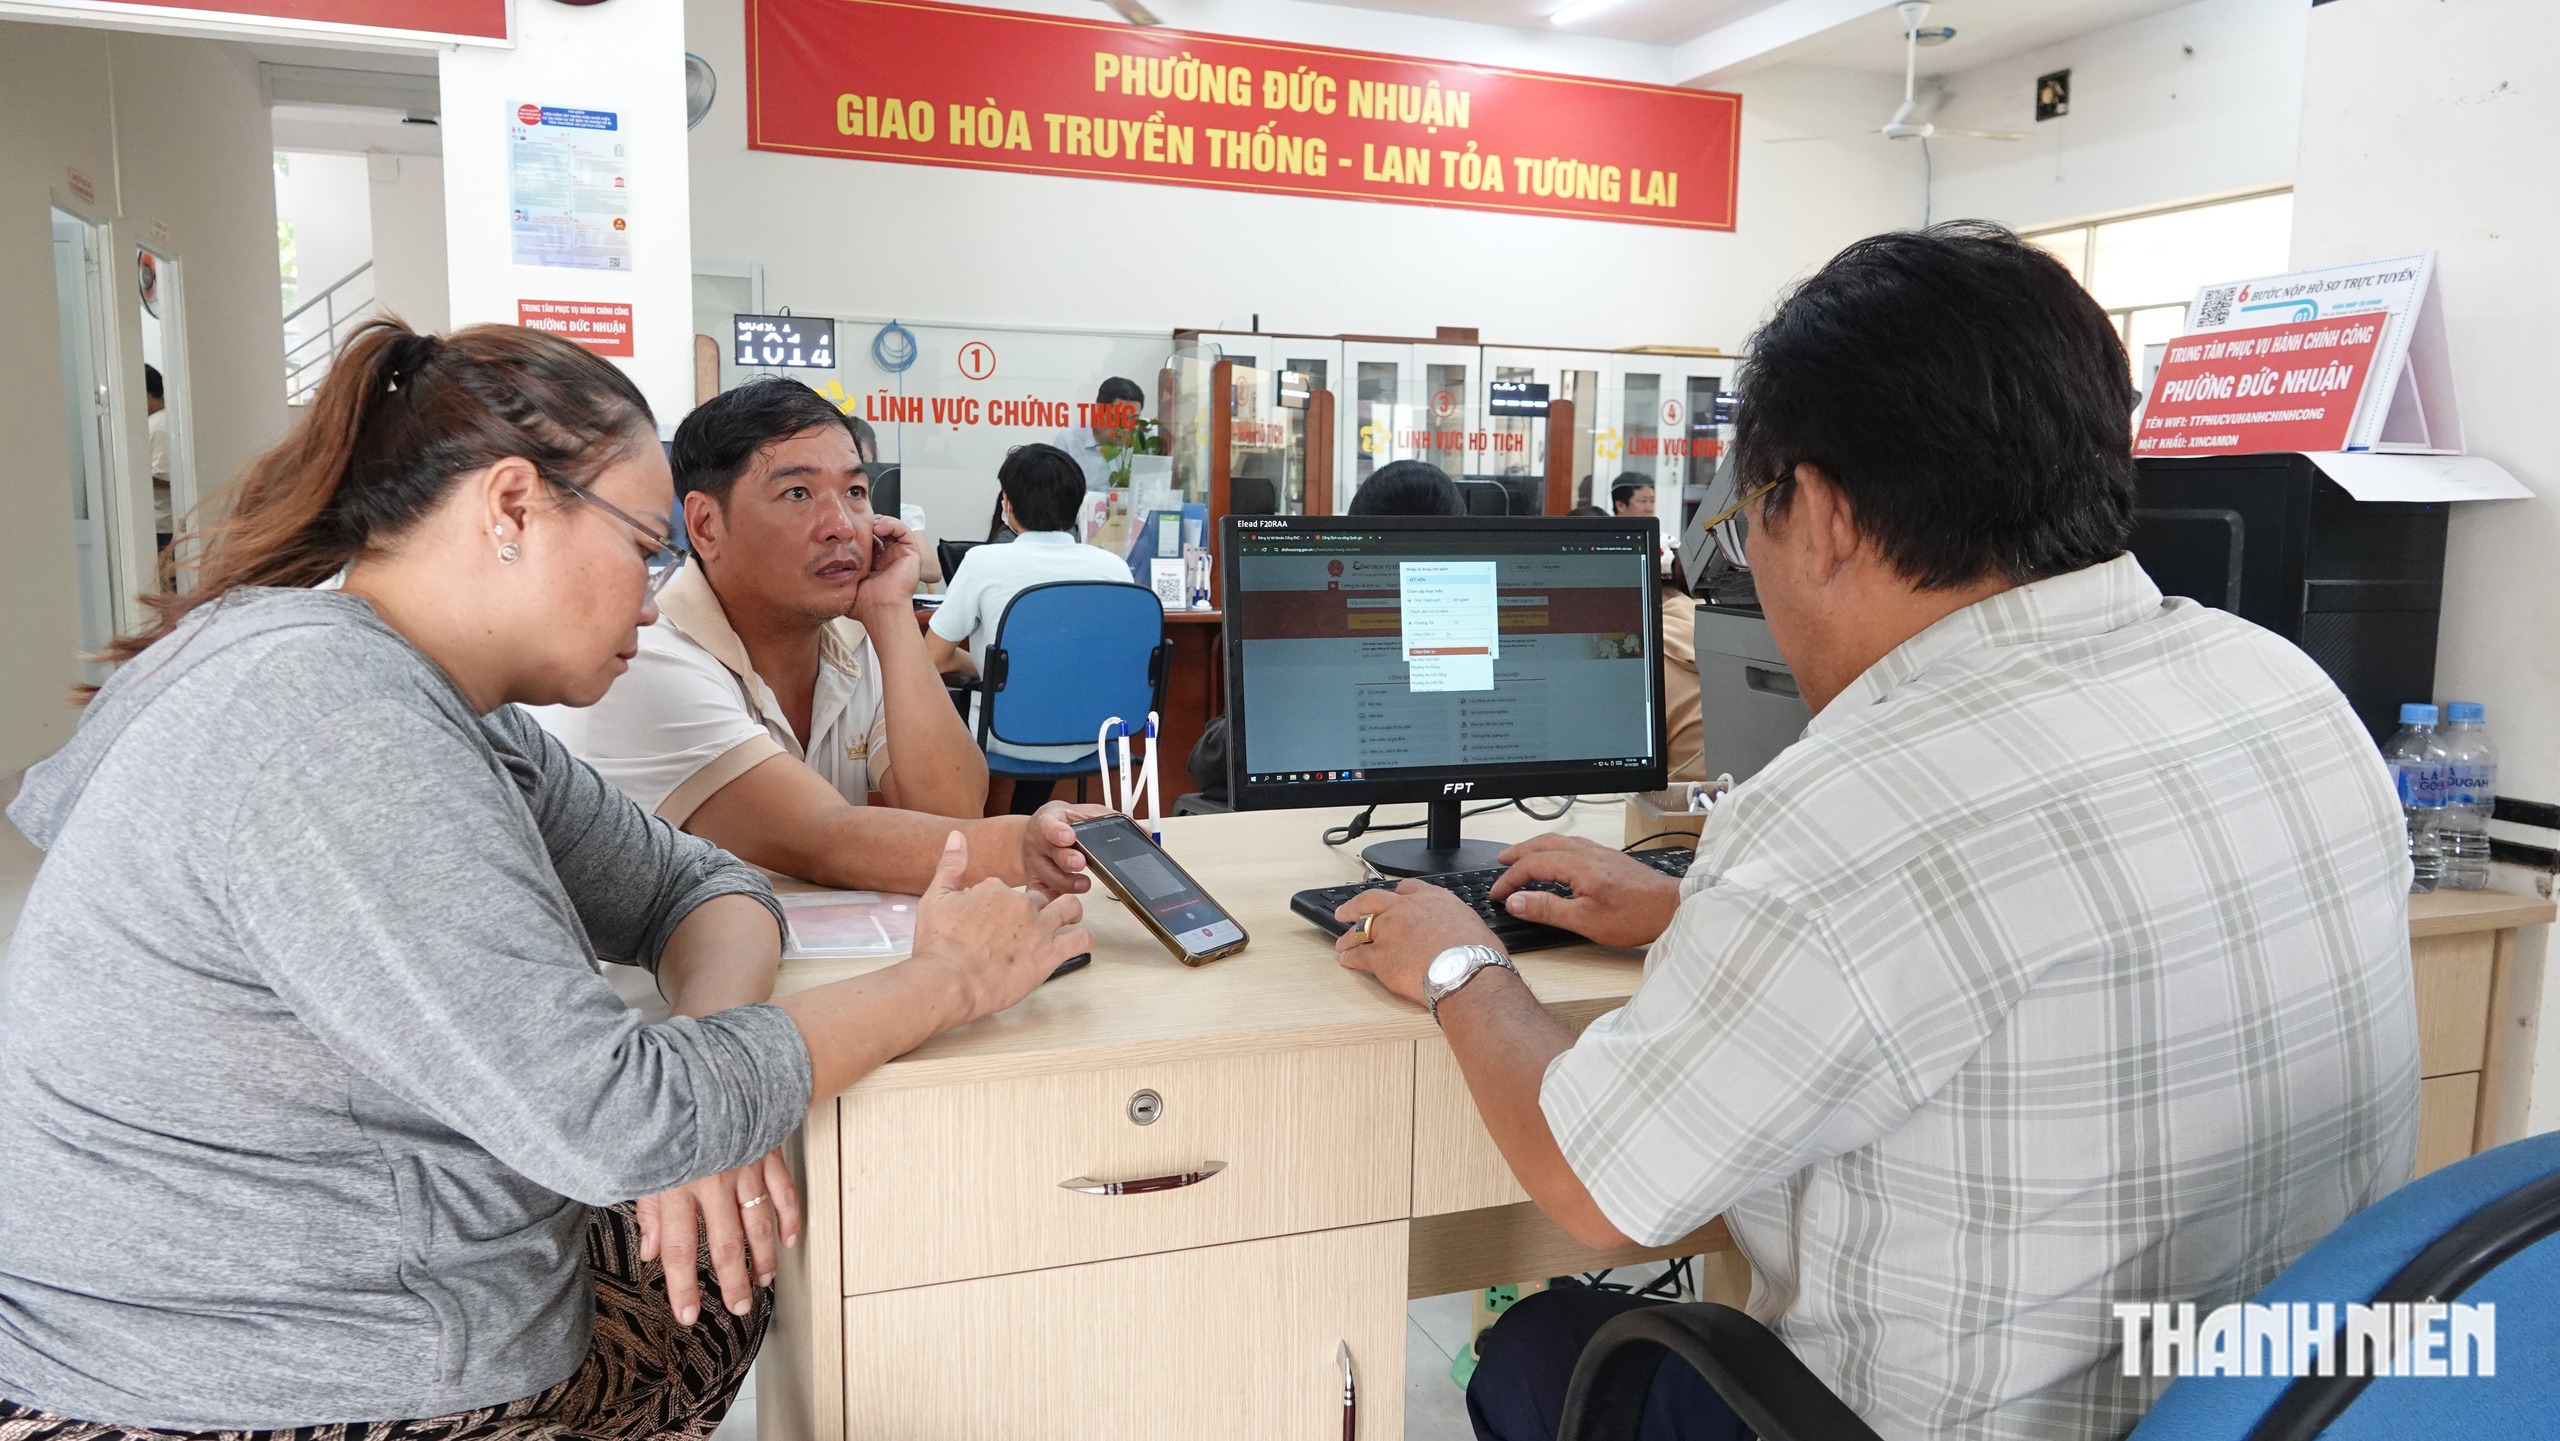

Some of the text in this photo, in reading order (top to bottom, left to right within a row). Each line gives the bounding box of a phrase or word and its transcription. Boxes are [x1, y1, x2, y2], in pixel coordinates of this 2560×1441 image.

[1095, 51, 1470, 135] PHƯỜNG ĐỨC NHUẬN
[836, 94, 1677, 208] GIAO HÒA TRUYỀN THỐNG - LAN TỎA TƯƠNG LAI
[2238, 268, 2416, 302] 6 BƯỚC NỘP HỒ SƠ TRỰC TUYẾN
[526, 318, 626, 335] PHƯỜNG ĐỨC NHUẬN
[2169, 322, 2374, 364] TRUNG TÂM PHỤC VỤ HÀNH CHÍNH CÔNG
[970, 349, 981, 373] 1
[2161, 361, 2353, 404] PHƯỜNG ĐỨC NHUẬN
[866, 389, 1136, 436] LĨNH VỰC CHỨNG THỰC
[1439, 394, 1449, 412] 3
[1668, 404, 1676, 420] 4
[2145, 408, 2324, 430] TÊN WIFI: TTPHUCVUHANHCHINHCONG
[1398, 425, 1523, 457] LĨNH VỰC HỘ TỊCH
[1628, 433, 1658, 455] LĨNH
[1664, 438, 1689, 462] VỰC
[1692, 439, 1724, 457] KINH
[2138, 432, 2239, 451] MẬT KHẨU: XINCAMON
[1237, 520, 1288, 528] Elead F20RAA
[1443, 782, 1474, 795] FPT
